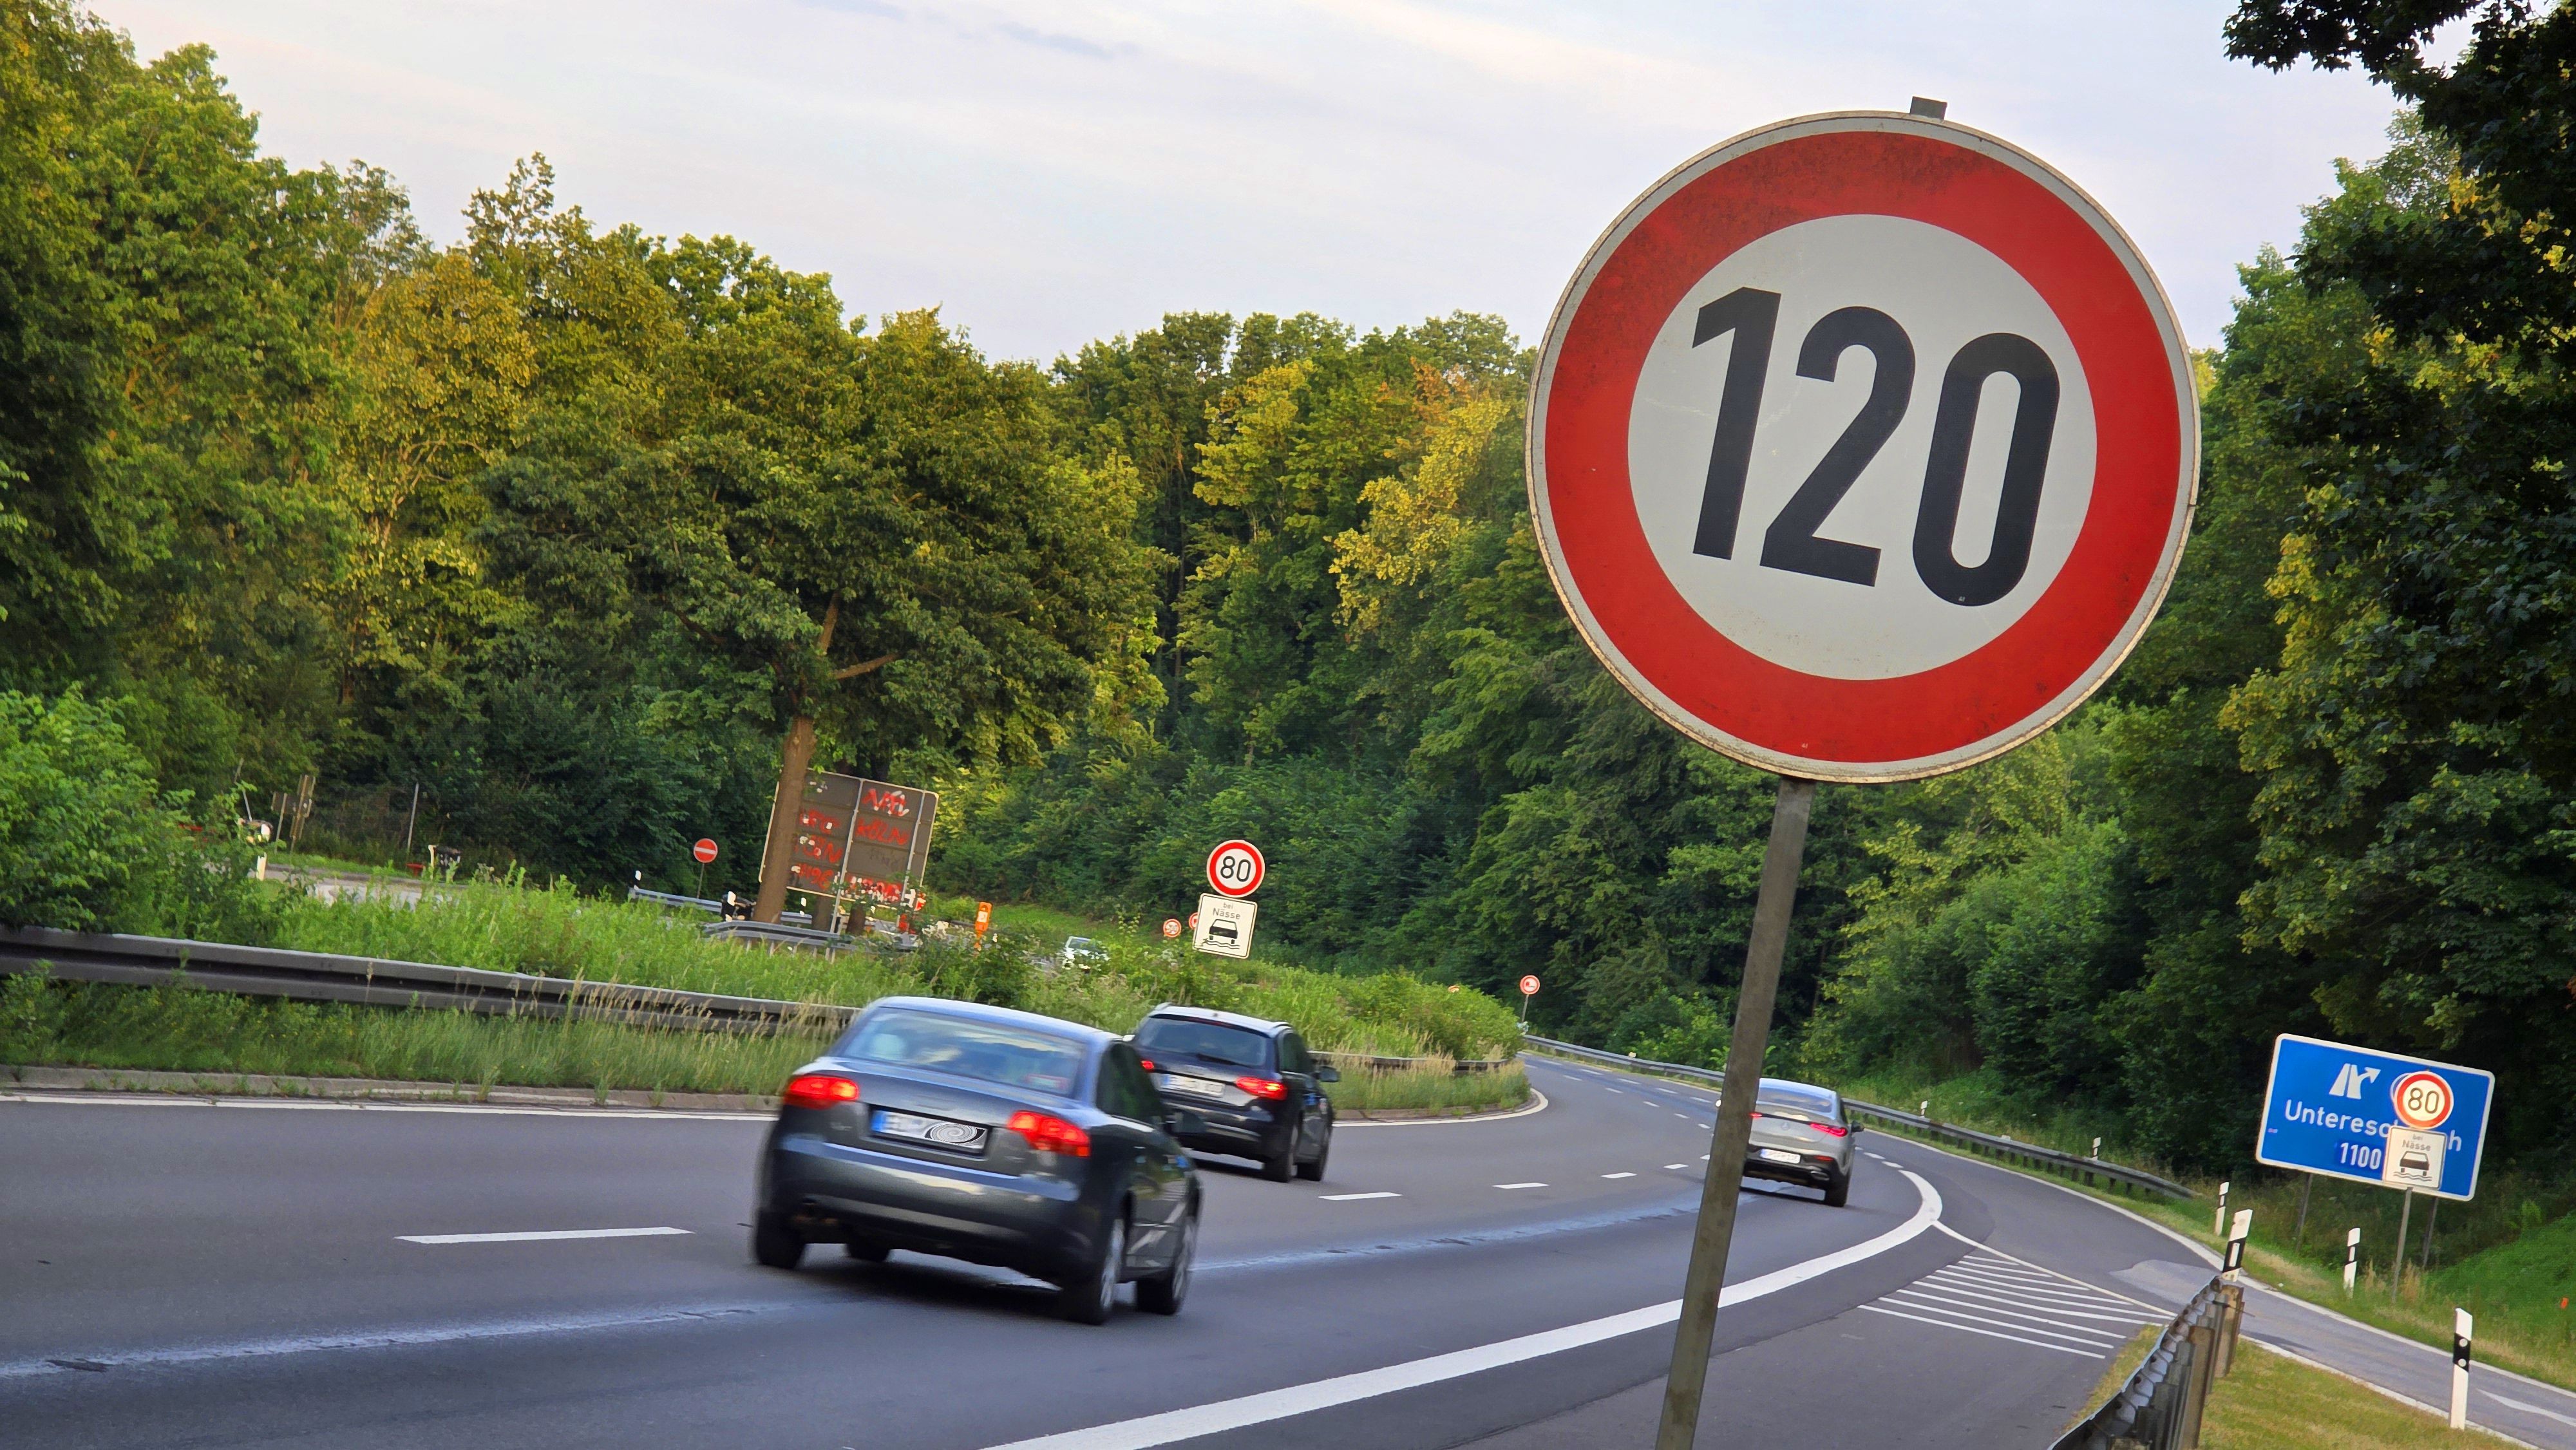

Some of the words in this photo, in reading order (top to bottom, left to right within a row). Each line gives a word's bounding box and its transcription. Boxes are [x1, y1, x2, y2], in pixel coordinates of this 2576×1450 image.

[1692, 287, 2060, 607] 120
[1220, 856, 1251, 882] 80
[1213, 908, 1241, 920] Nässe
[2408, 1088, 2439, 1114] 80
[2285, 1099, 2462, 1151] Unteresch
[2340, 1142, 2382, 1170] 1100
[2402, 1140, 2431, 1151] Nässe
